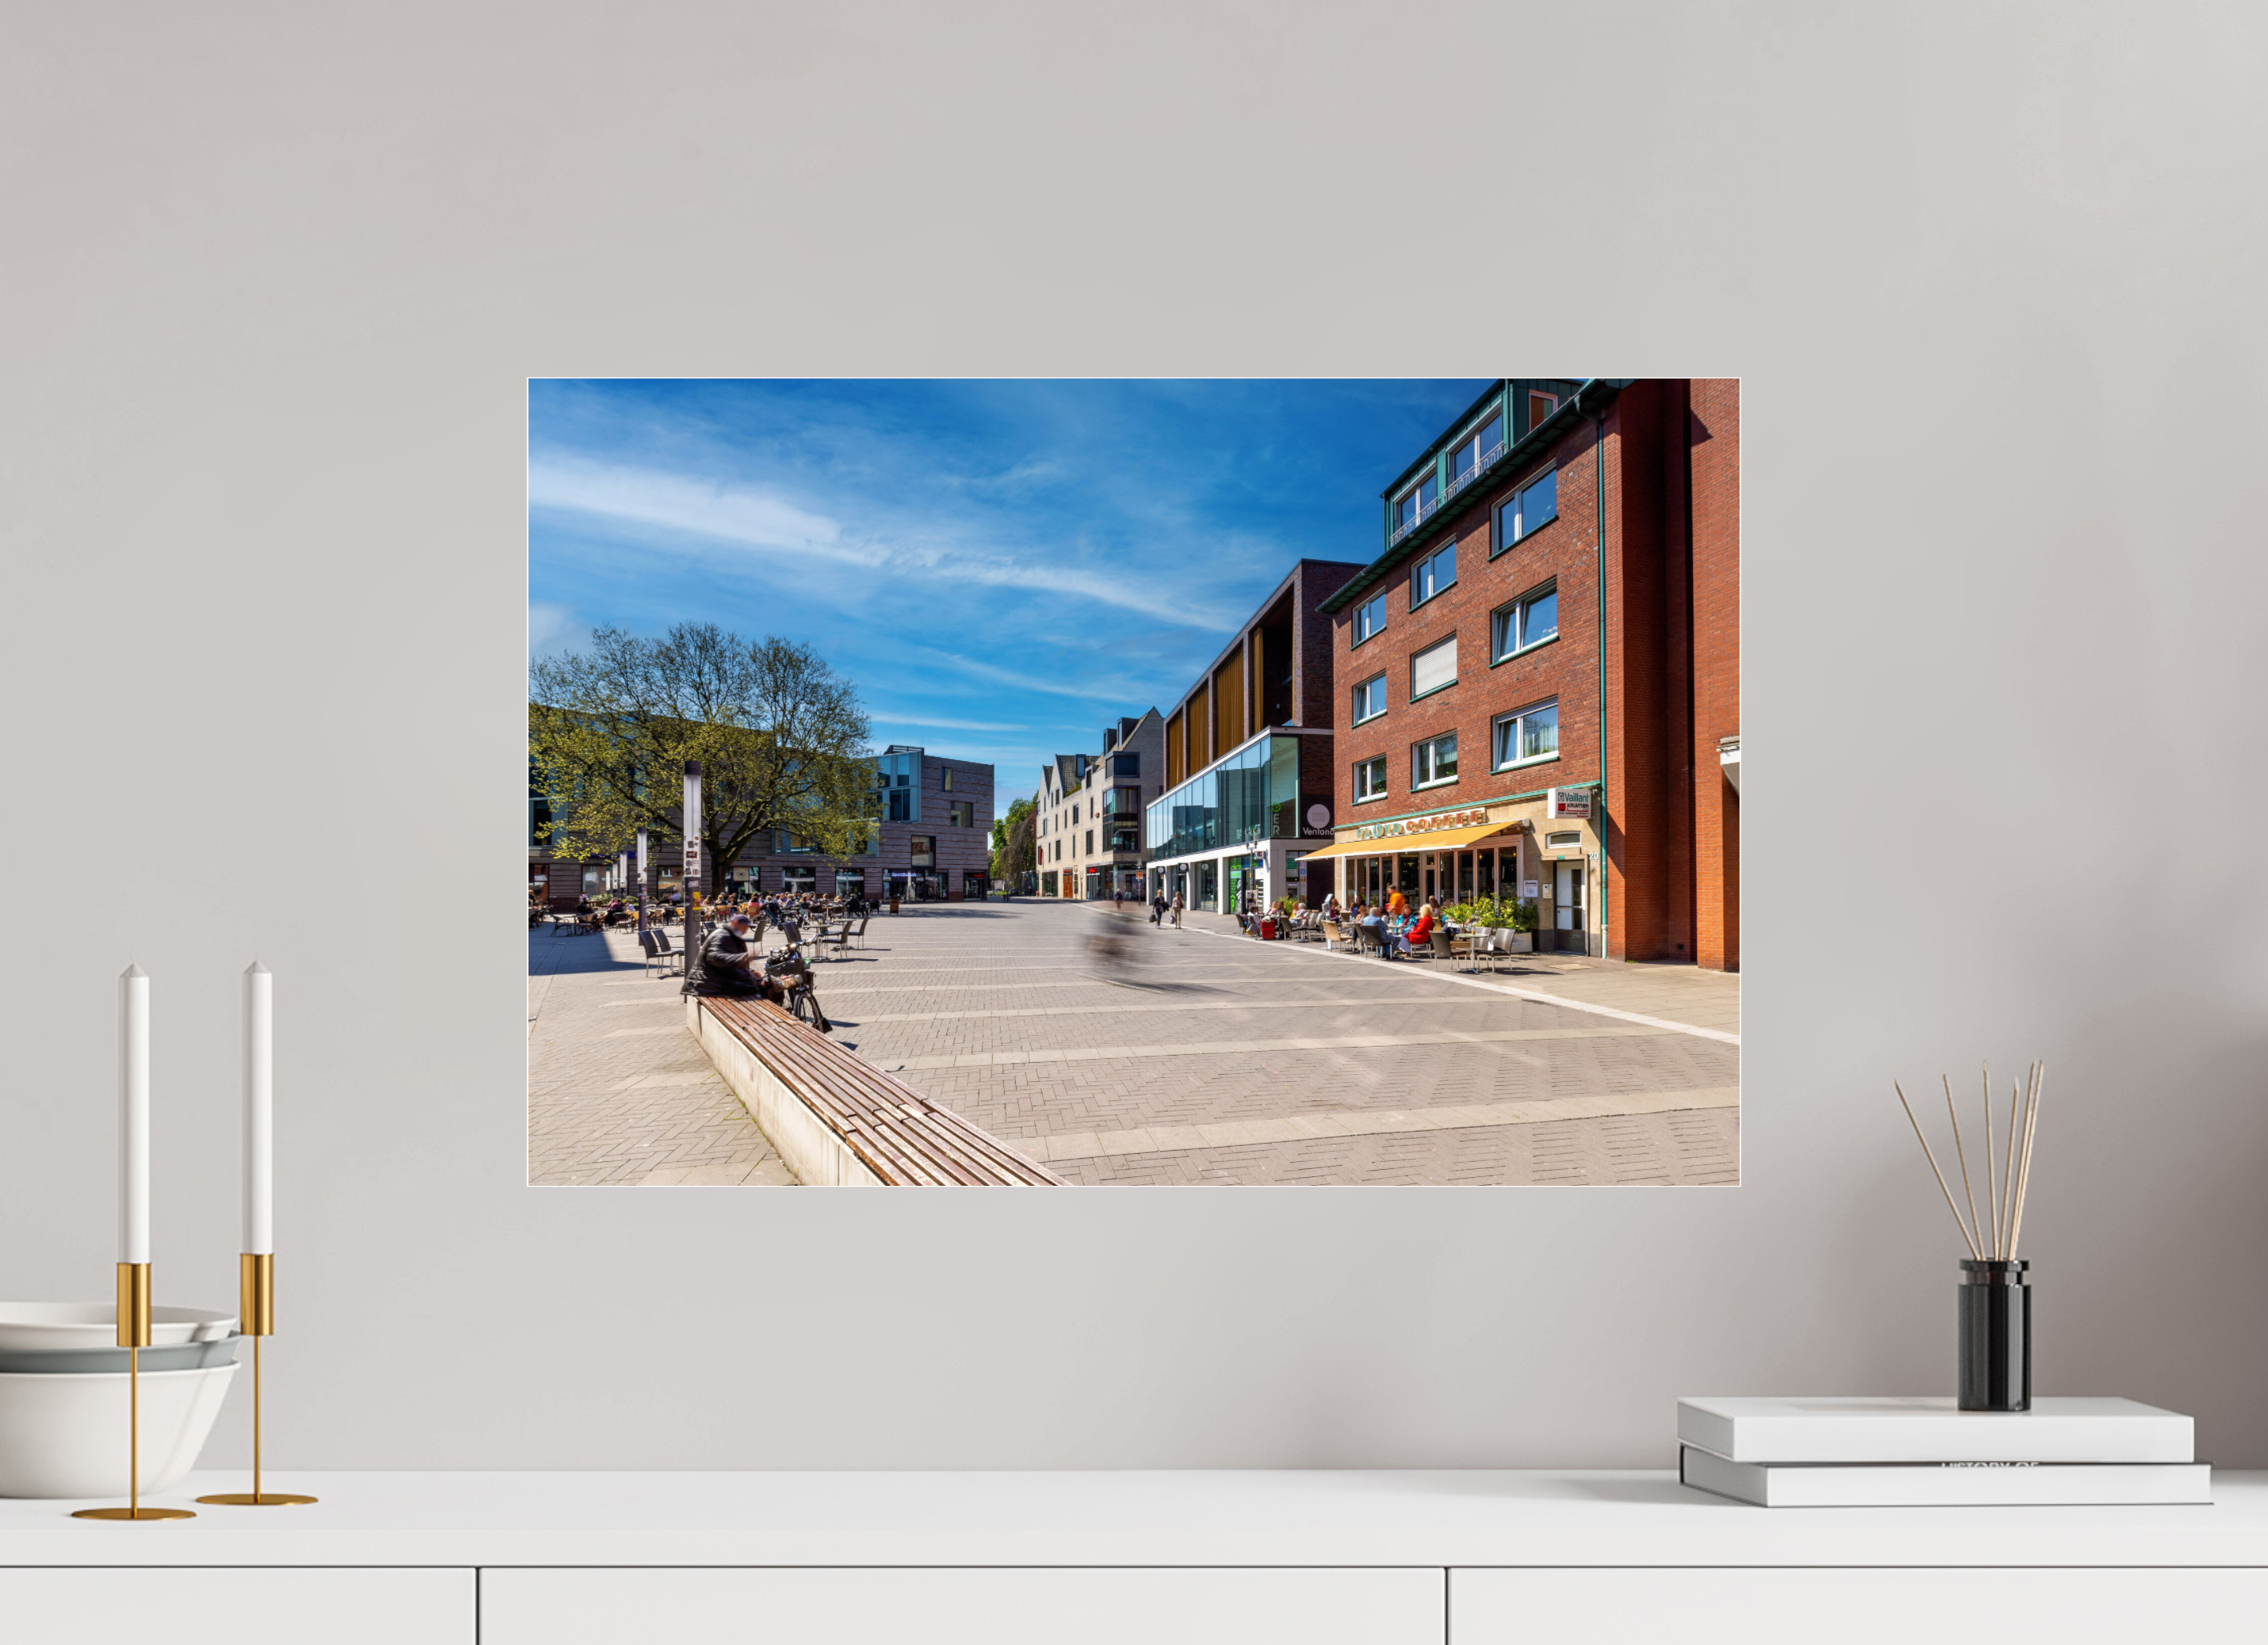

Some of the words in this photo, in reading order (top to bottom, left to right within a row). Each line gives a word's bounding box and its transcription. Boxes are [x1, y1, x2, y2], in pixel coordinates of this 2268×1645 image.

[1564, 792, 1589, 803] Vaillant
[1356, 823, 1402, 838] FLOYD
[1406, 810, 1483, 832] COFFEE
[1588, 851, 1599, 860] 20
